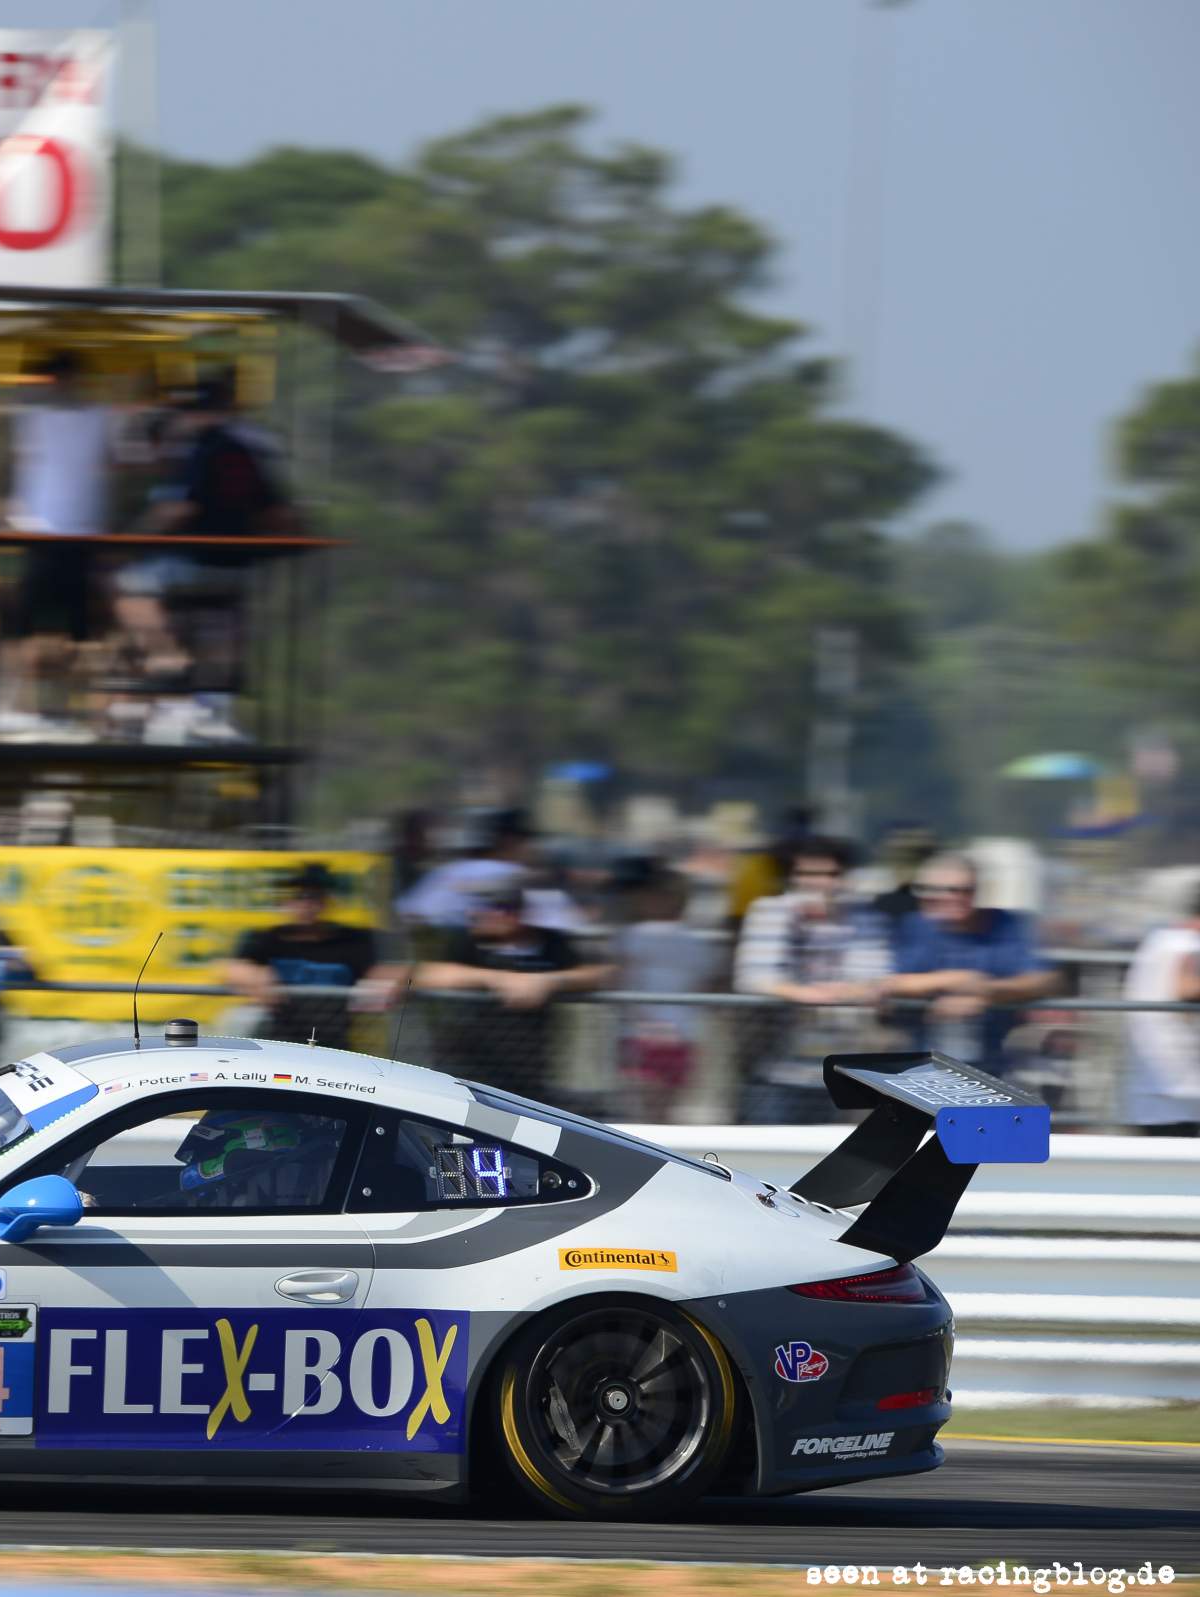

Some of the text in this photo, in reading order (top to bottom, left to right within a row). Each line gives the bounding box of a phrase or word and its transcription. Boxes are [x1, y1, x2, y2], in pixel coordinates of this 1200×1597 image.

[139, 1074, 187, 1087] Potter
[214, 1072, 267, 1083] A. Lally
[295, 1075, 376, 1094] M. Seefried
[564, 1250, 657, 1268] Continental
[775, 1341, 813, 1382] VP
[47, 1317, 458, 1441] FLEX-BOX
[791, 1432, 895, 1456] FORGELINE
